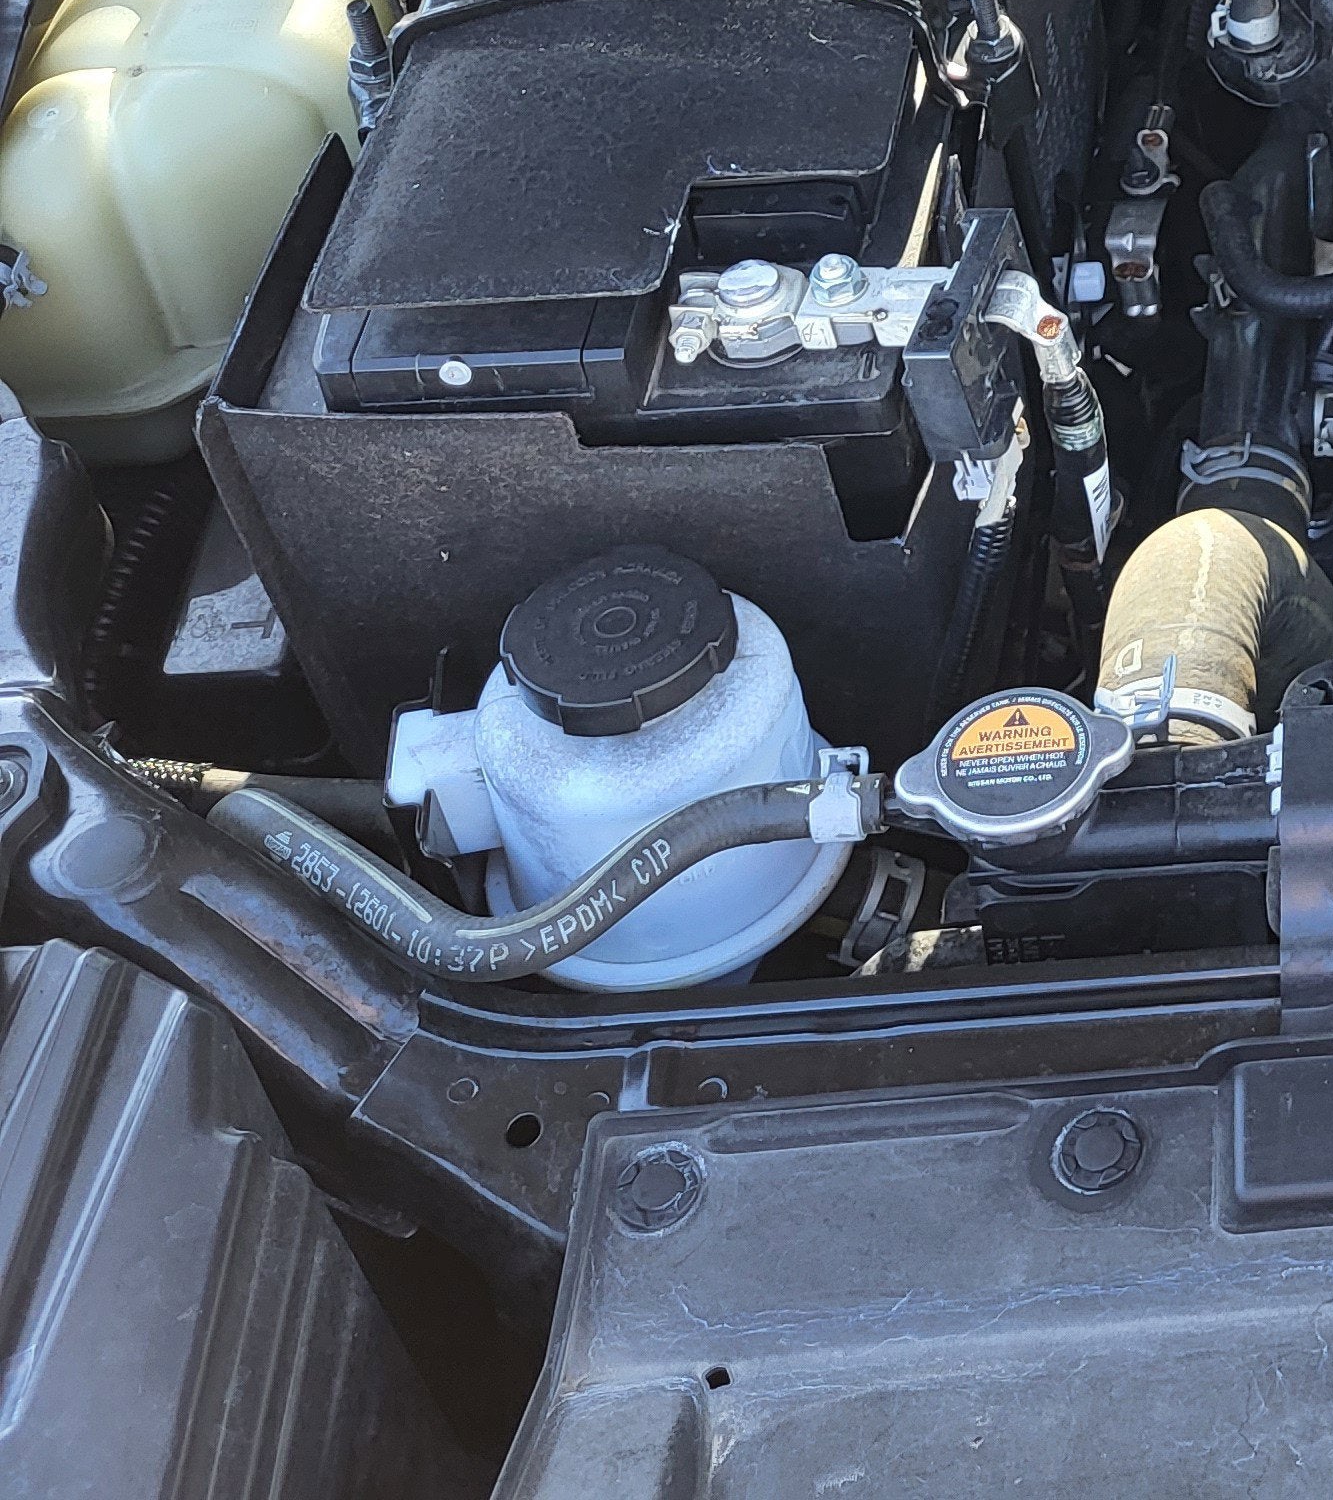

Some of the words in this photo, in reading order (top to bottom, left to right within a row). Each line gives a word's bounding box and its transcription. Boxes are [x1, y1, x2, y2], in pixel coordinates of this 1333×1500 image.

[978, 726, 1052, 742] WARNING
[959, 737, 1069, 756] AVERTISSEMENT
[959, 756, 988, 767] NEVER
[989, 754, 1015, 765] OPEN
[1017, 752, 1044, 763] WHEN
[955, 768, 967, 777] NE
[967, 765, 997, 776] JAMAIS
